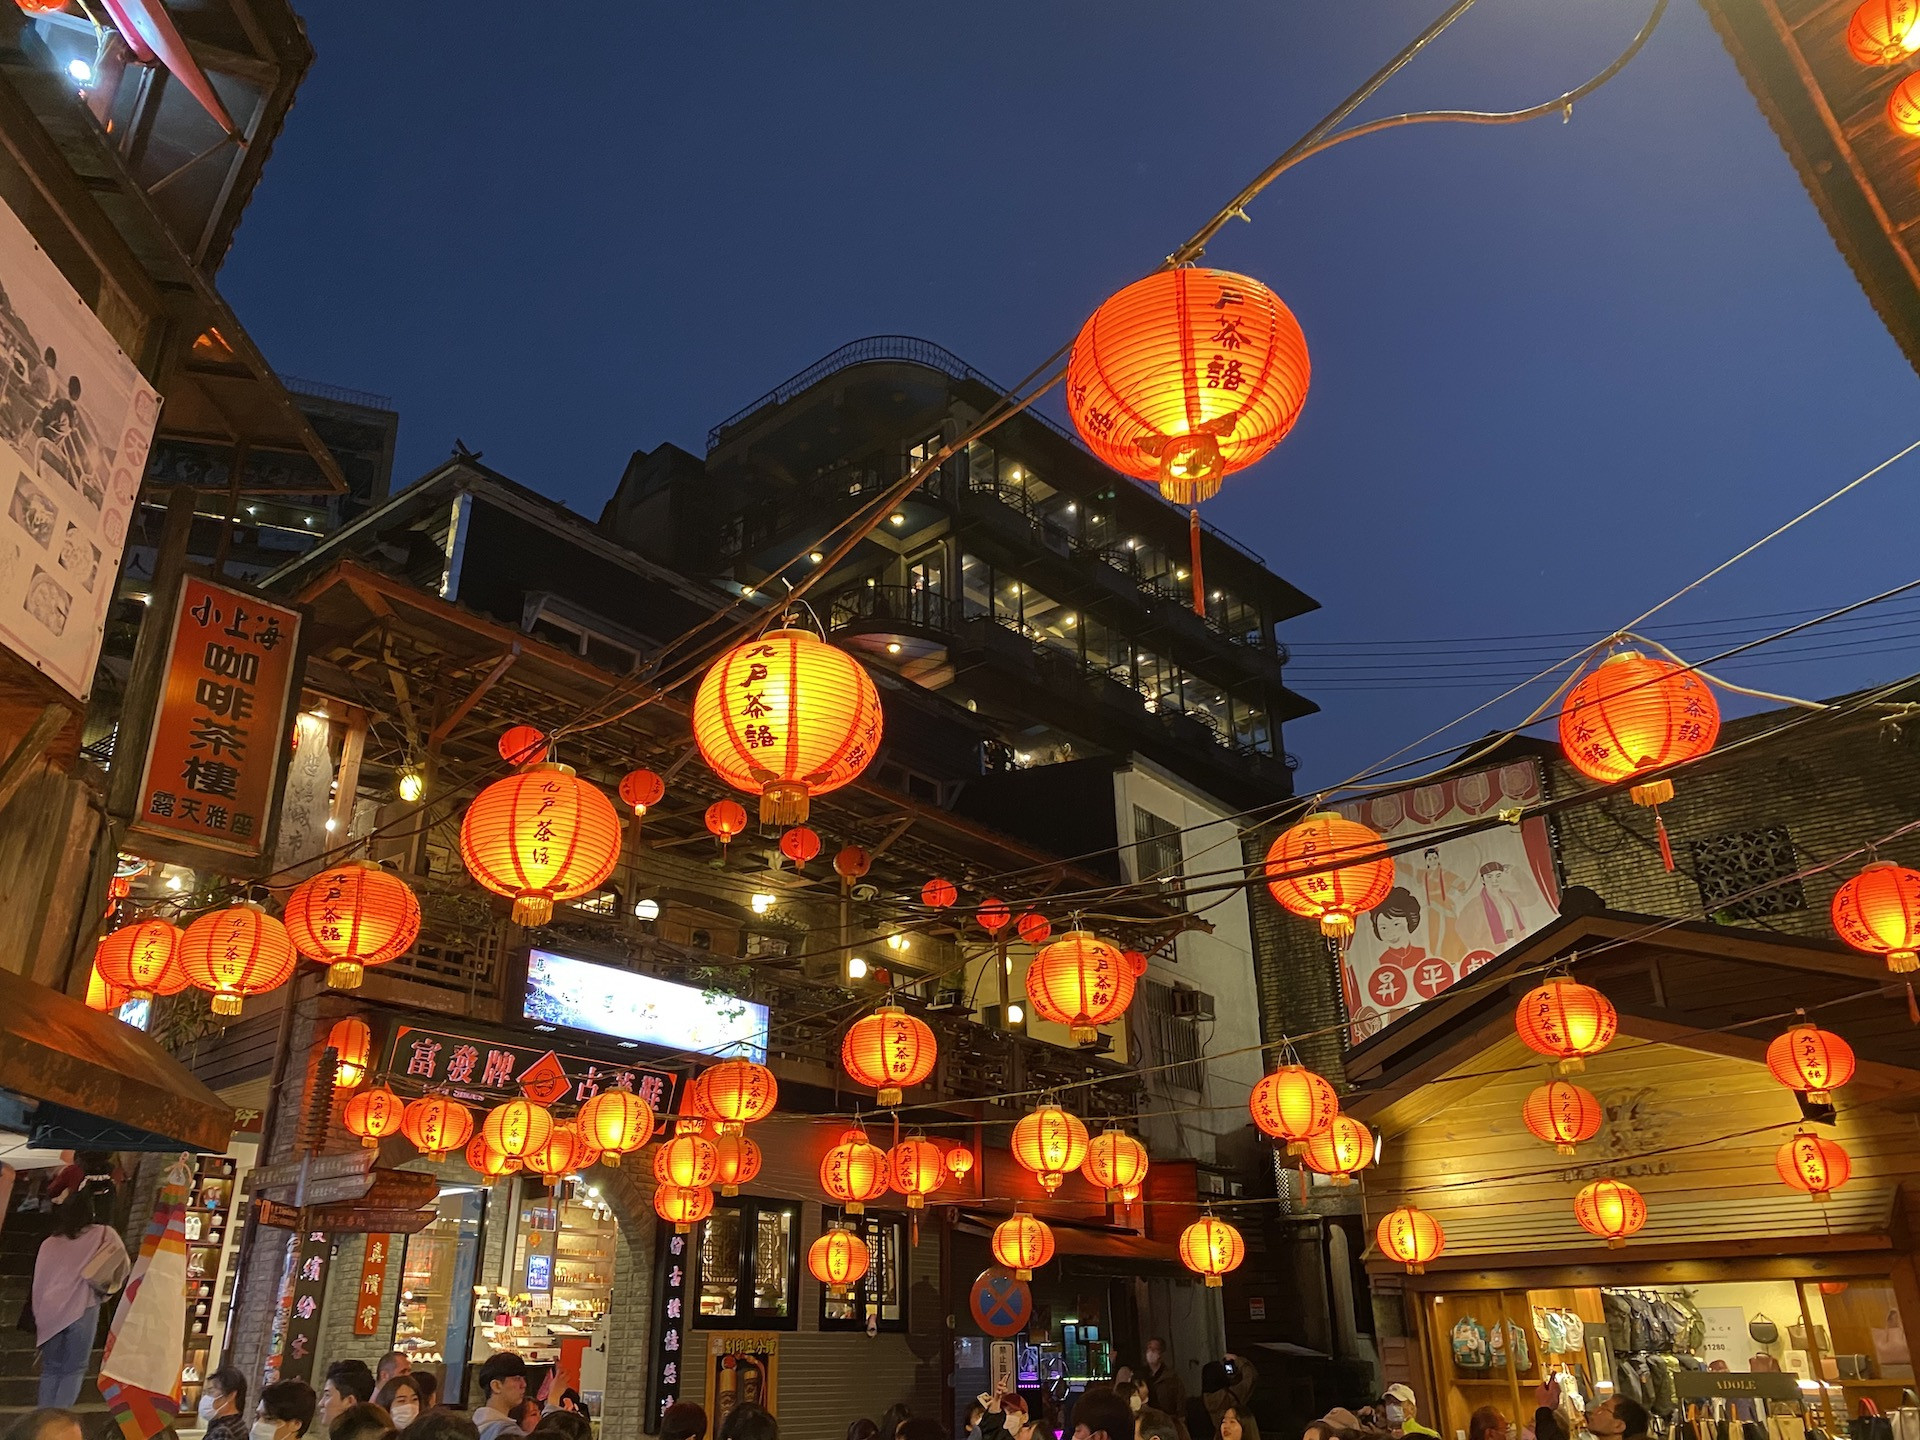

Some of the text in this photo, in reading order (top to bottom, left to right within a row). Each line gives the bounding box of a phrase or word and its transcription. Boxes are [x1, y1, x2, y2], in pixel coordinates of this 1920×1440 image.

[190, 595, 285, 650] 小上海
[181, 642, 260, 801] 咖啡茶樓
[150, 790, 254, 837] 露天雅座
[406, 1038, 516, 1088] 富發牌
